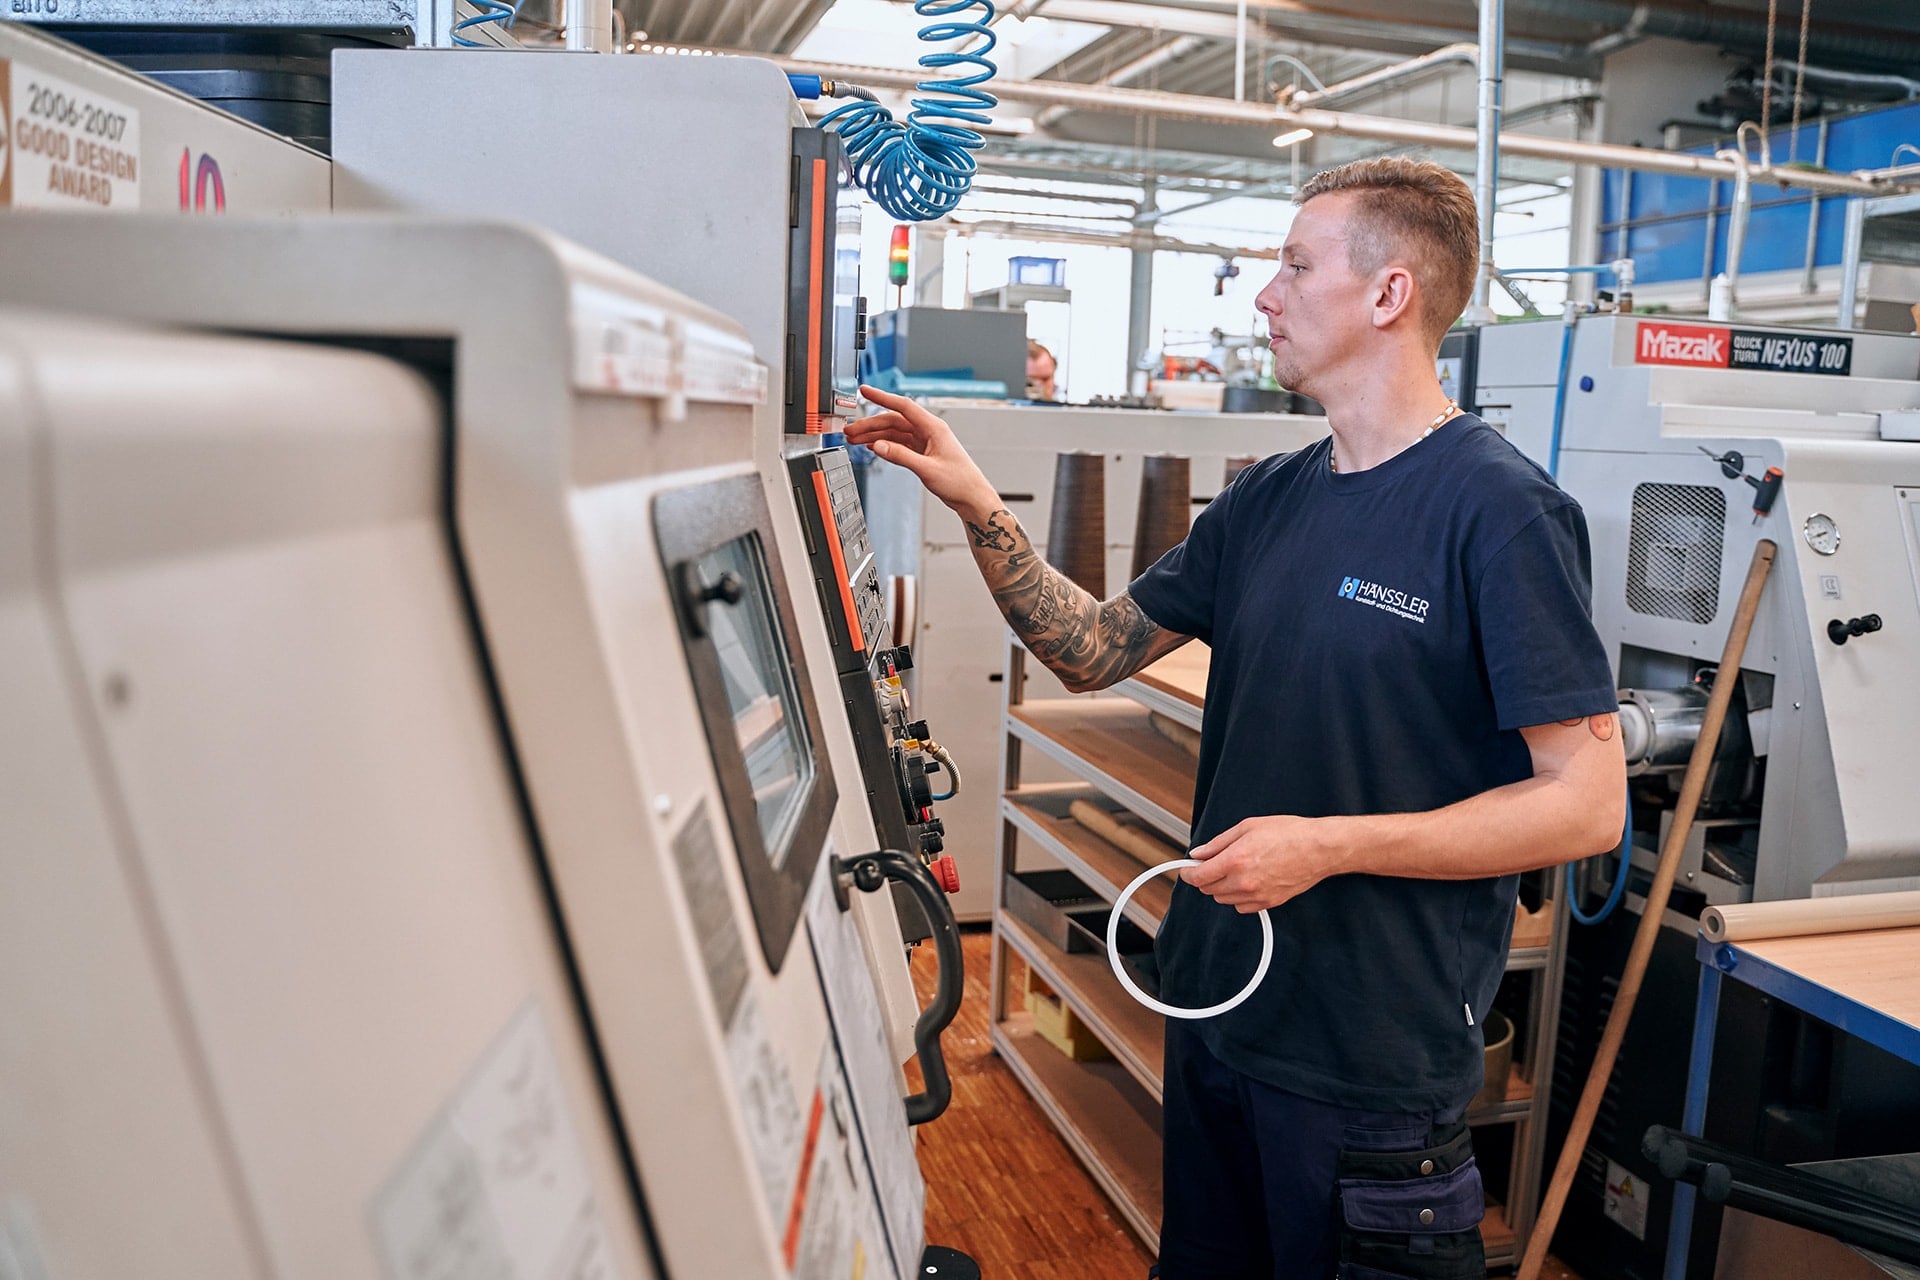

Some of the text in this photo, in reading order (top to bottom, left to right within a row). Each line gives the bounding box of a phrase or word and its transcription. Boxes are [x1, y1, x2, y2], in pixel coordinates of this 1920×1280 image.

[27, 82, 127, 142] 2006-2007
[16, 117, 137, 183] GOOD DESIGN
[48, 164, 112, 207] AWARD
[1641, 328, 1723, 363] Mazak
[1733, 334, 1763, 350] QUICK
[1733, 349, 1759, 363] TURN
[1761, 338, 1847, 369] NEXUS 100
[1357, 580, 1430, 617] HÄNSSLER
